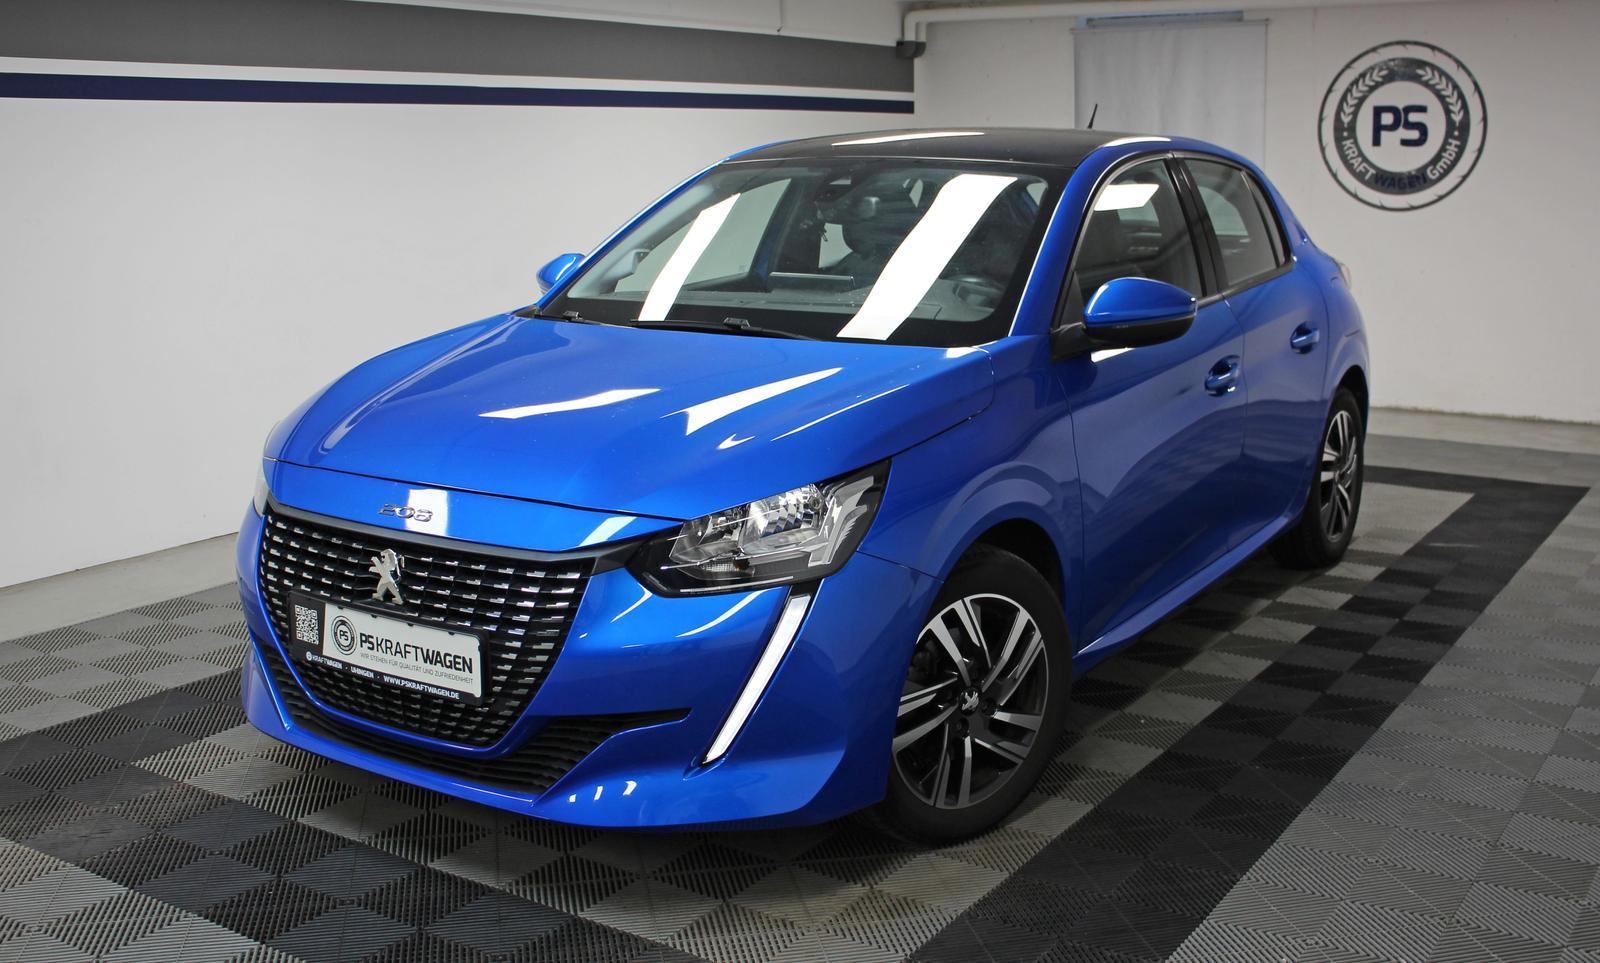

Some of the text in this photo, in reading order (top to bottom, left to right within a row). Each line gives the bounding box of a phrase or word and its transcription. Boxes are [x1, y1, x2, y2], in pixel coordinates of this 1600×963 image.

[1371, 105, 1429, 147] PS
[1426, 138, 1461, 180] GmbH
[377, 503, 434, 522] 208
[339, 629, 349, 641] PS
[383, 675, 460, 700] WWW.PSKRAFTWAGEN.DE
